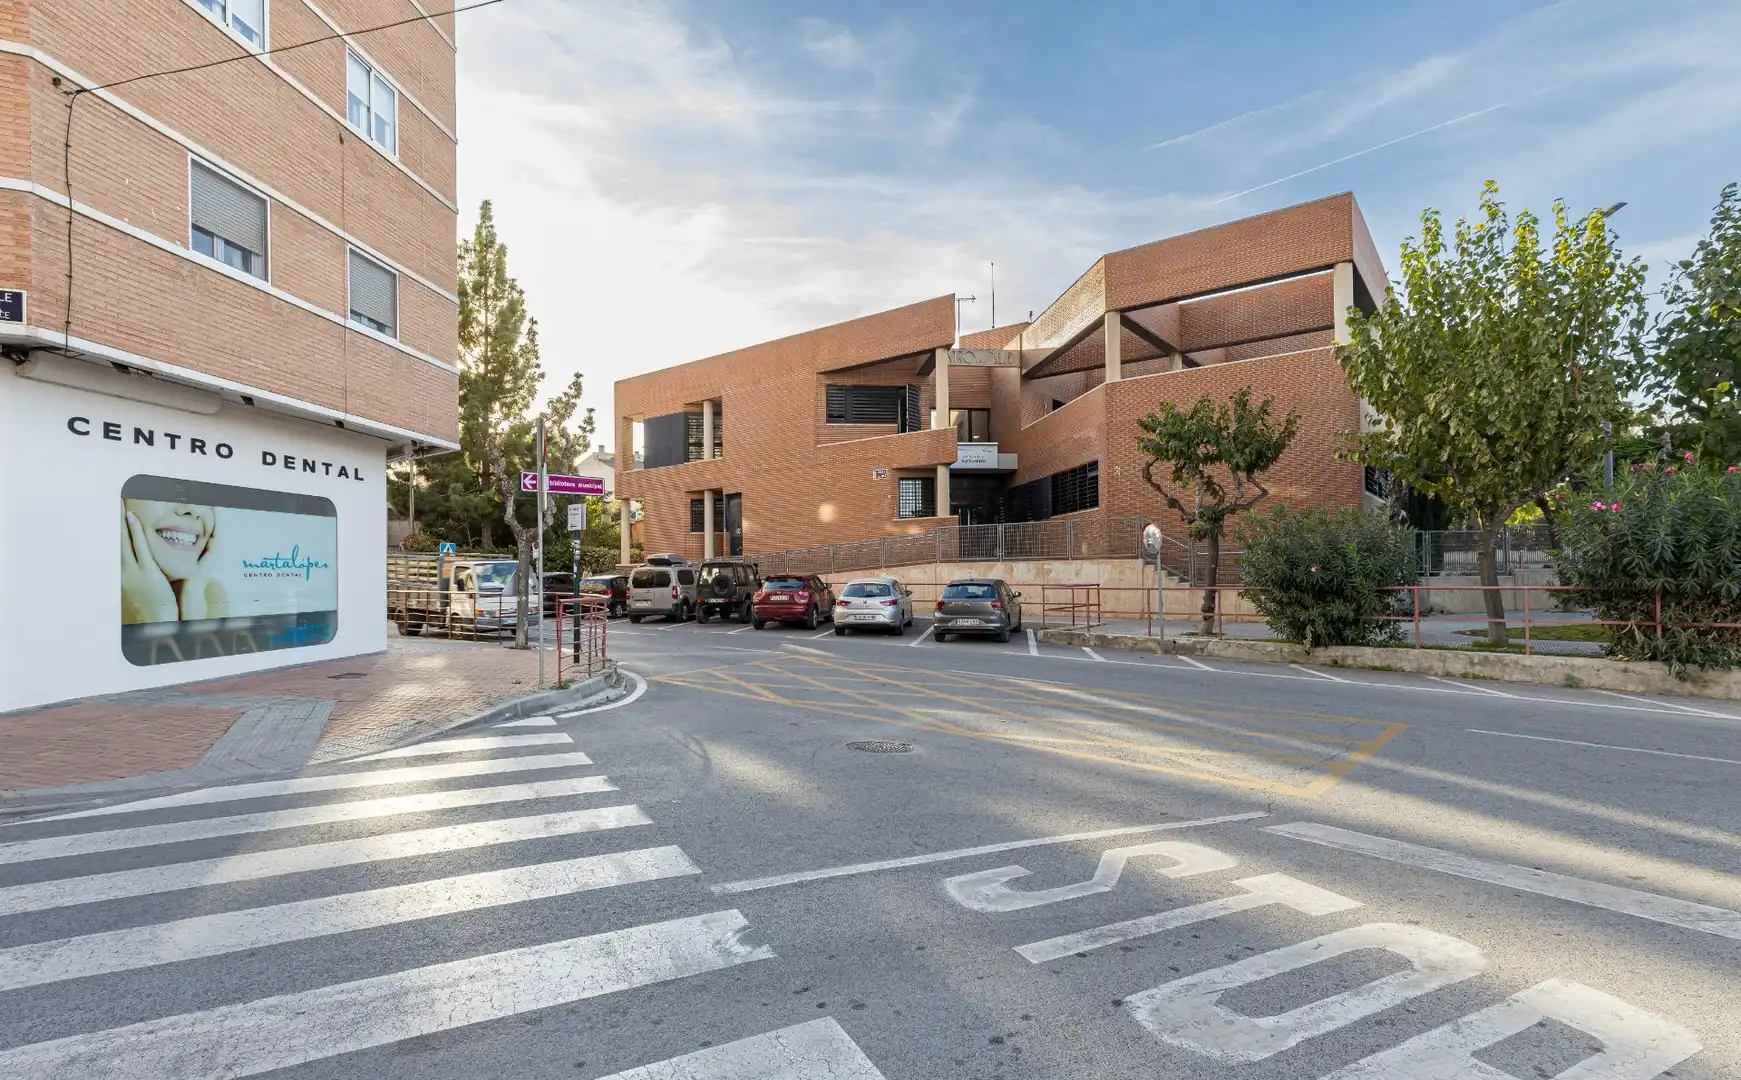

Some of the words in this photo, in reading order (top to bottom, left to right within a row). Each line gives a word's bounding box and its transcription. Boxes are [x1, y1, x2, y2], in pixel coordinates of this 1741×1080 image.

[67, 416, 234, 459] CENTRO
[261, 450, 365, 481] DENTAL
[943, 840, 1703, 1080] STOP
